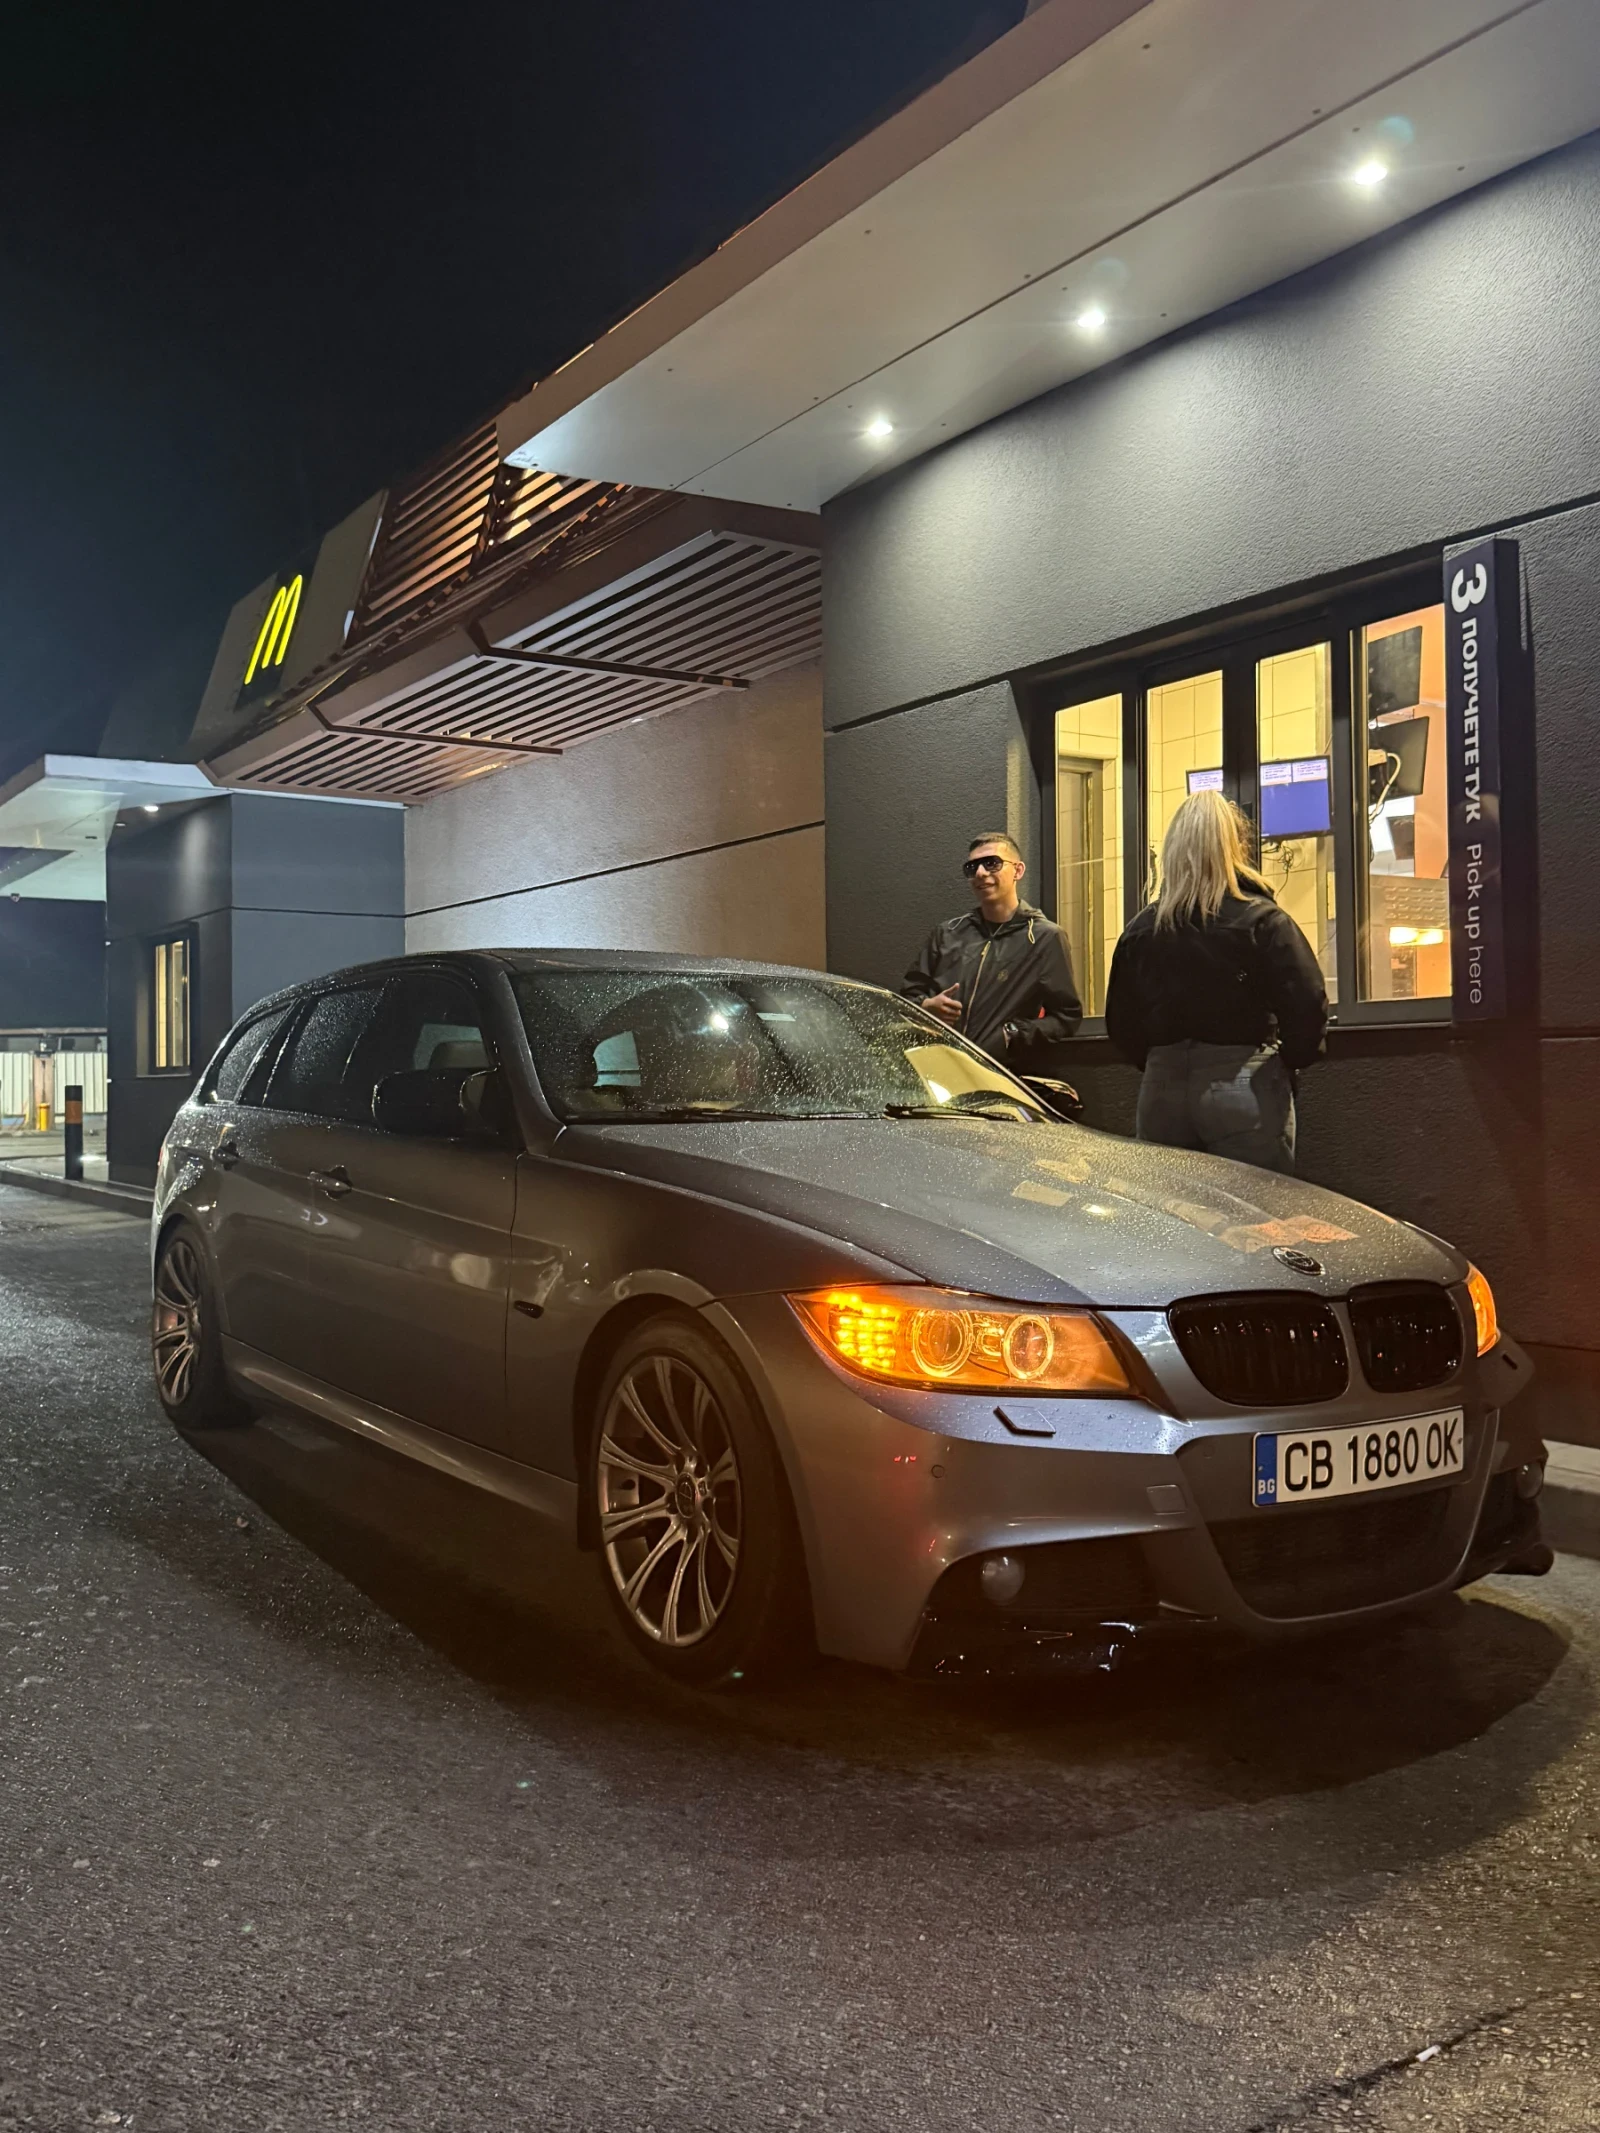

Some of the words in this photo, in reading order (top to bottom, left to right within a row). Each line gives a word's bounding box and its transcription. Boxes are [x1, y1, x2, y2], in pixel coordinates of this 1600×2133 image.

[1451, 563, 1487, 613] 3
[1466, 843, 1483, 900] Pick
[1464, 906, 1480, 939] up
[1469, 946, 1485, 1004] here
[1284, 1440, 1333, 1492] CB
[1347, 1427, 1419, 1485] 1880
[1426, 1417, 1458, 1470] OK
[1257, 1478, 1275, 1495] BG
